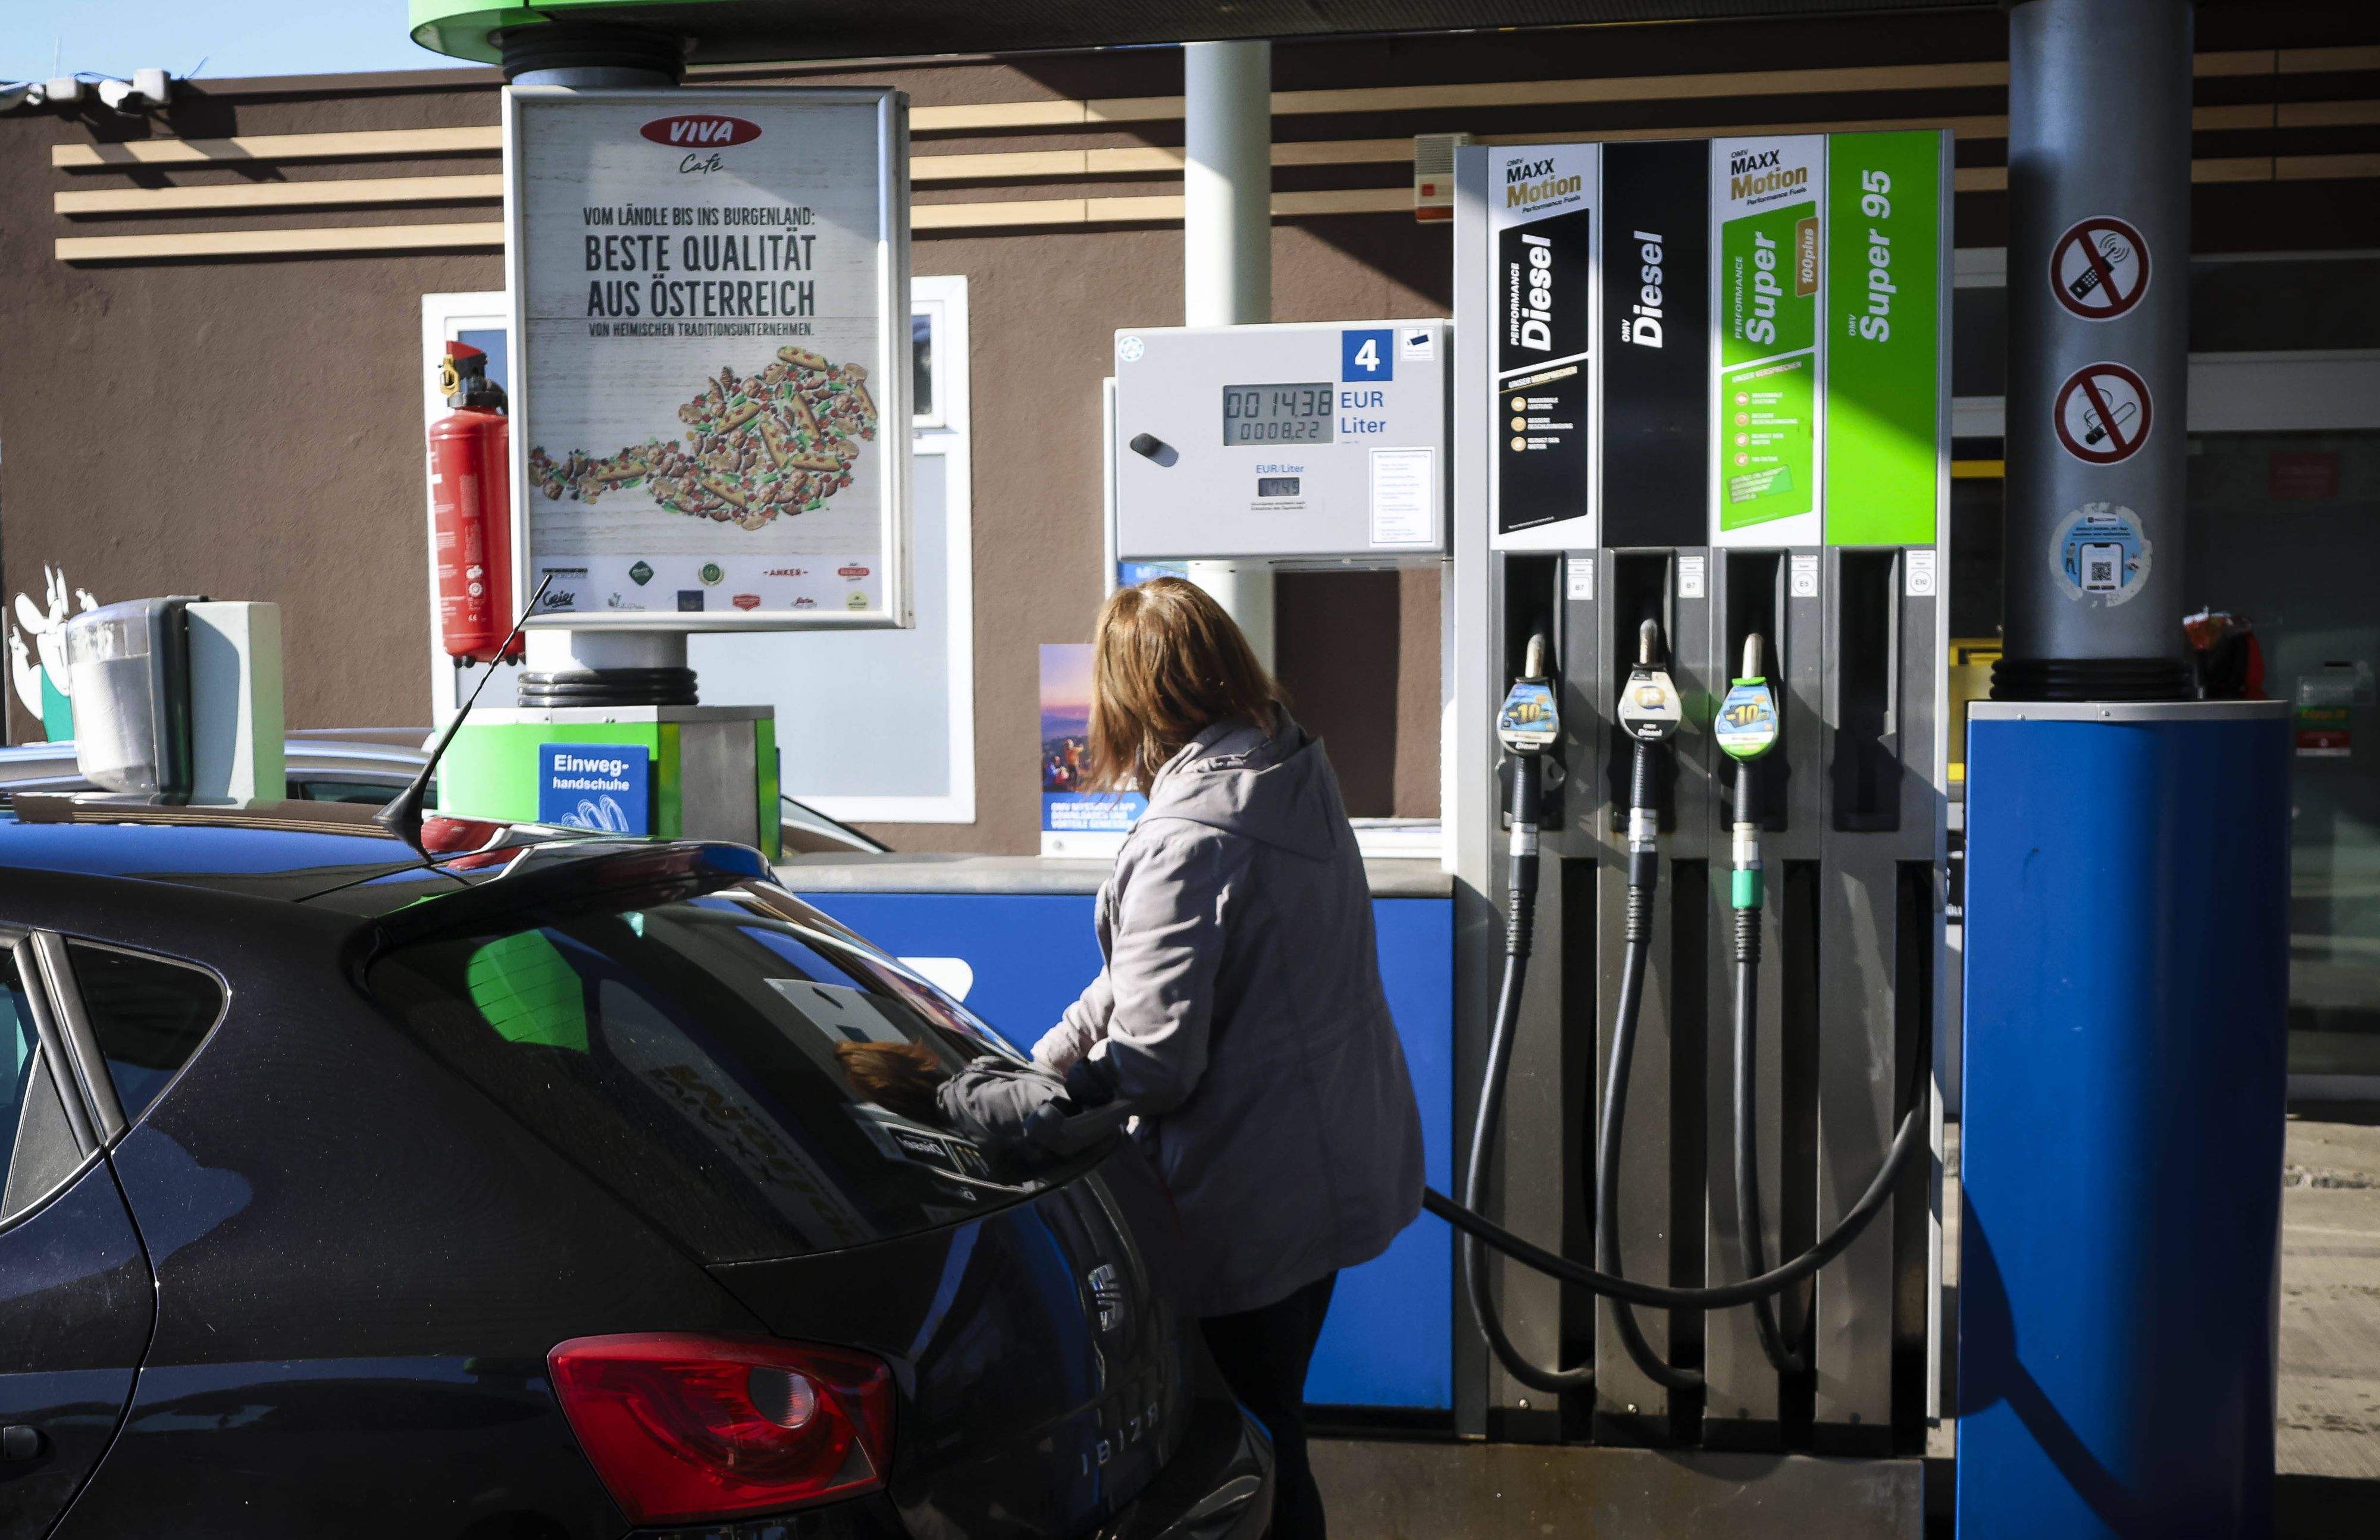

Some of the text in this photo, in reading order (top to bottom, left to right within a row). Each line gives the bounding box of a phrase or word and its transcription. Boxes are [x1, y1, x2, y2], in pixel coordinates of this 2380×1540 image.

[669, 120, 735, 143] VIVA
[679, 153, 724, 174] Café
[1507, 158, 1555, 183] MAXX
[1731, 149, 1780, 175] MAXX
[1507, 175, 1582, 208] Motion
[1731, 166, 1808, 200] Motion
[1522, 200, 1562, 214] Performance
[1746, 192, 1789, 205] Performance
[583, 203, 816, 225] VOM LÄNDLE BIS INS BURGENLAND:
[585, 227, 816, 271] BESTE QUALITÄT
[1802, 228, 1814, 284] 100plus
[1859, 170, 1897, 343] Super 95
[587, 274, 815, 317] AUS ÖSTERREICH
[1521, 233, 1552, 352] Diesel
[1633, 230, 1664, 349] Diesel
[1734, 256, 1743, 339] PERFORMANCE
[1745, 231, 1783, 345] Super
[1510, 262, 1520, 345] PERFORMANCE
[588, 322, 815, 337] VON HEIMISCHEN TRADITIONSUNTERNEHMEN.
[1622, 319, 1631, 342] OMV
[1354, 338, 1380, 372] 4
[1341, 390, 1385, 409] EUR
[1341, 417, 1386, 434] Liter
[554, 754, 630, 777] Einweg-
[553, 776, 630, 791] handschuhe
